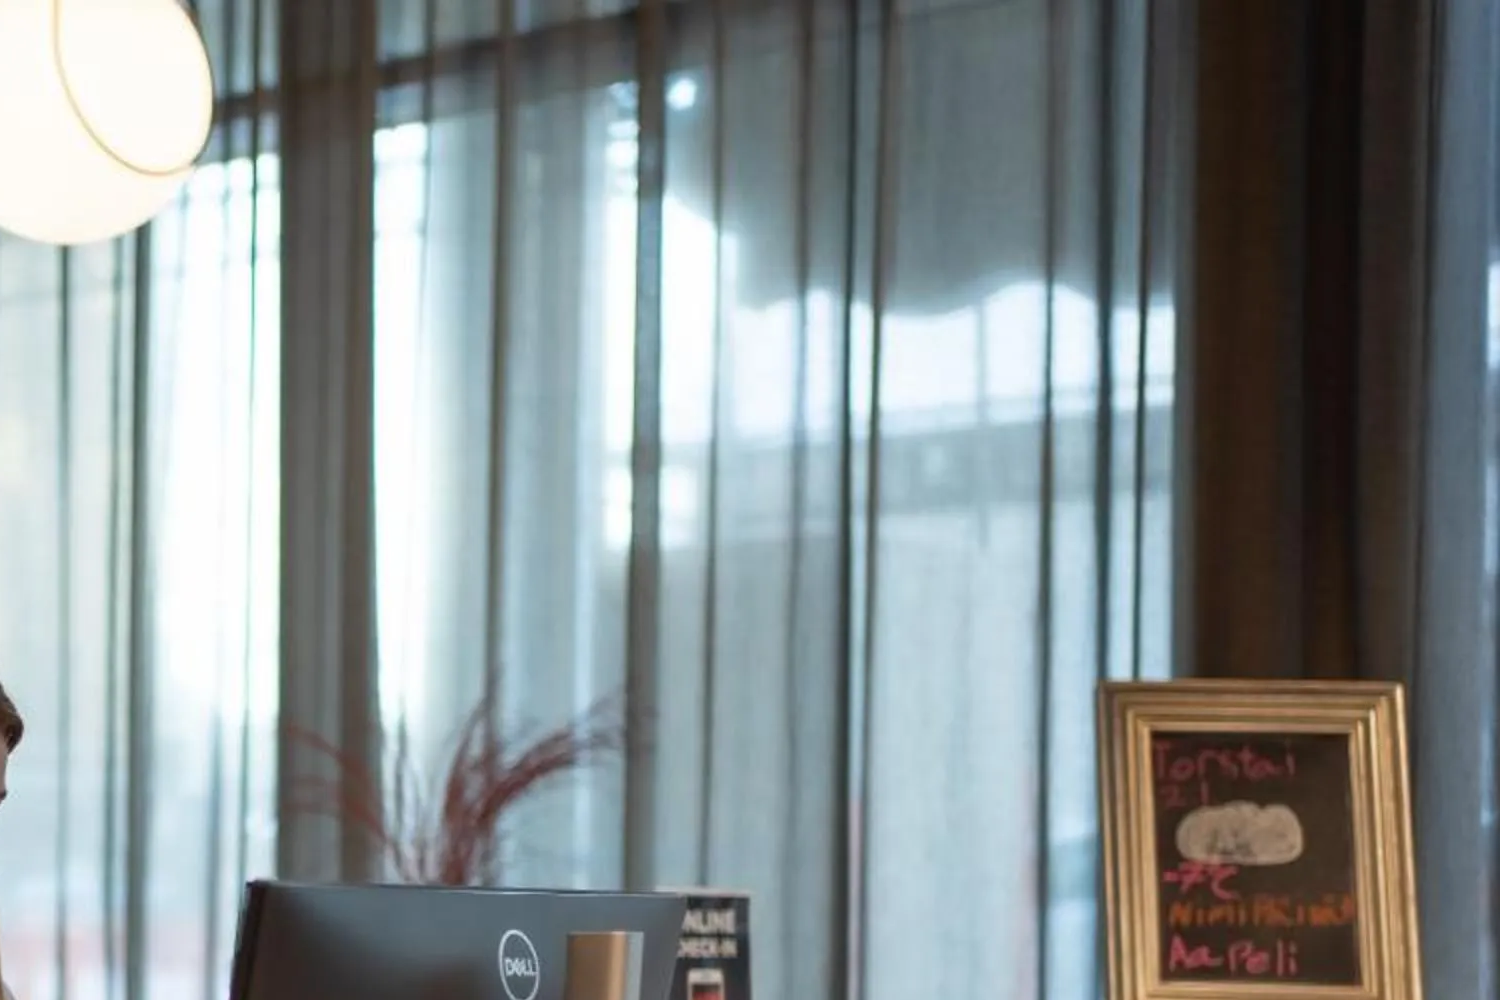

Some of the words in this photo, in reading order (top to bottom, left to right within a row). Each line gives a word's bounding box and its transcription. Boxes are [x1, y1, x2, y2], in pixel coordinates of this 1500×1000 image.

[681, 908, 736, 934] NLINE
[677, 938, 739, 958] HECK-IN
[505, 957, 538, 977] DELL
